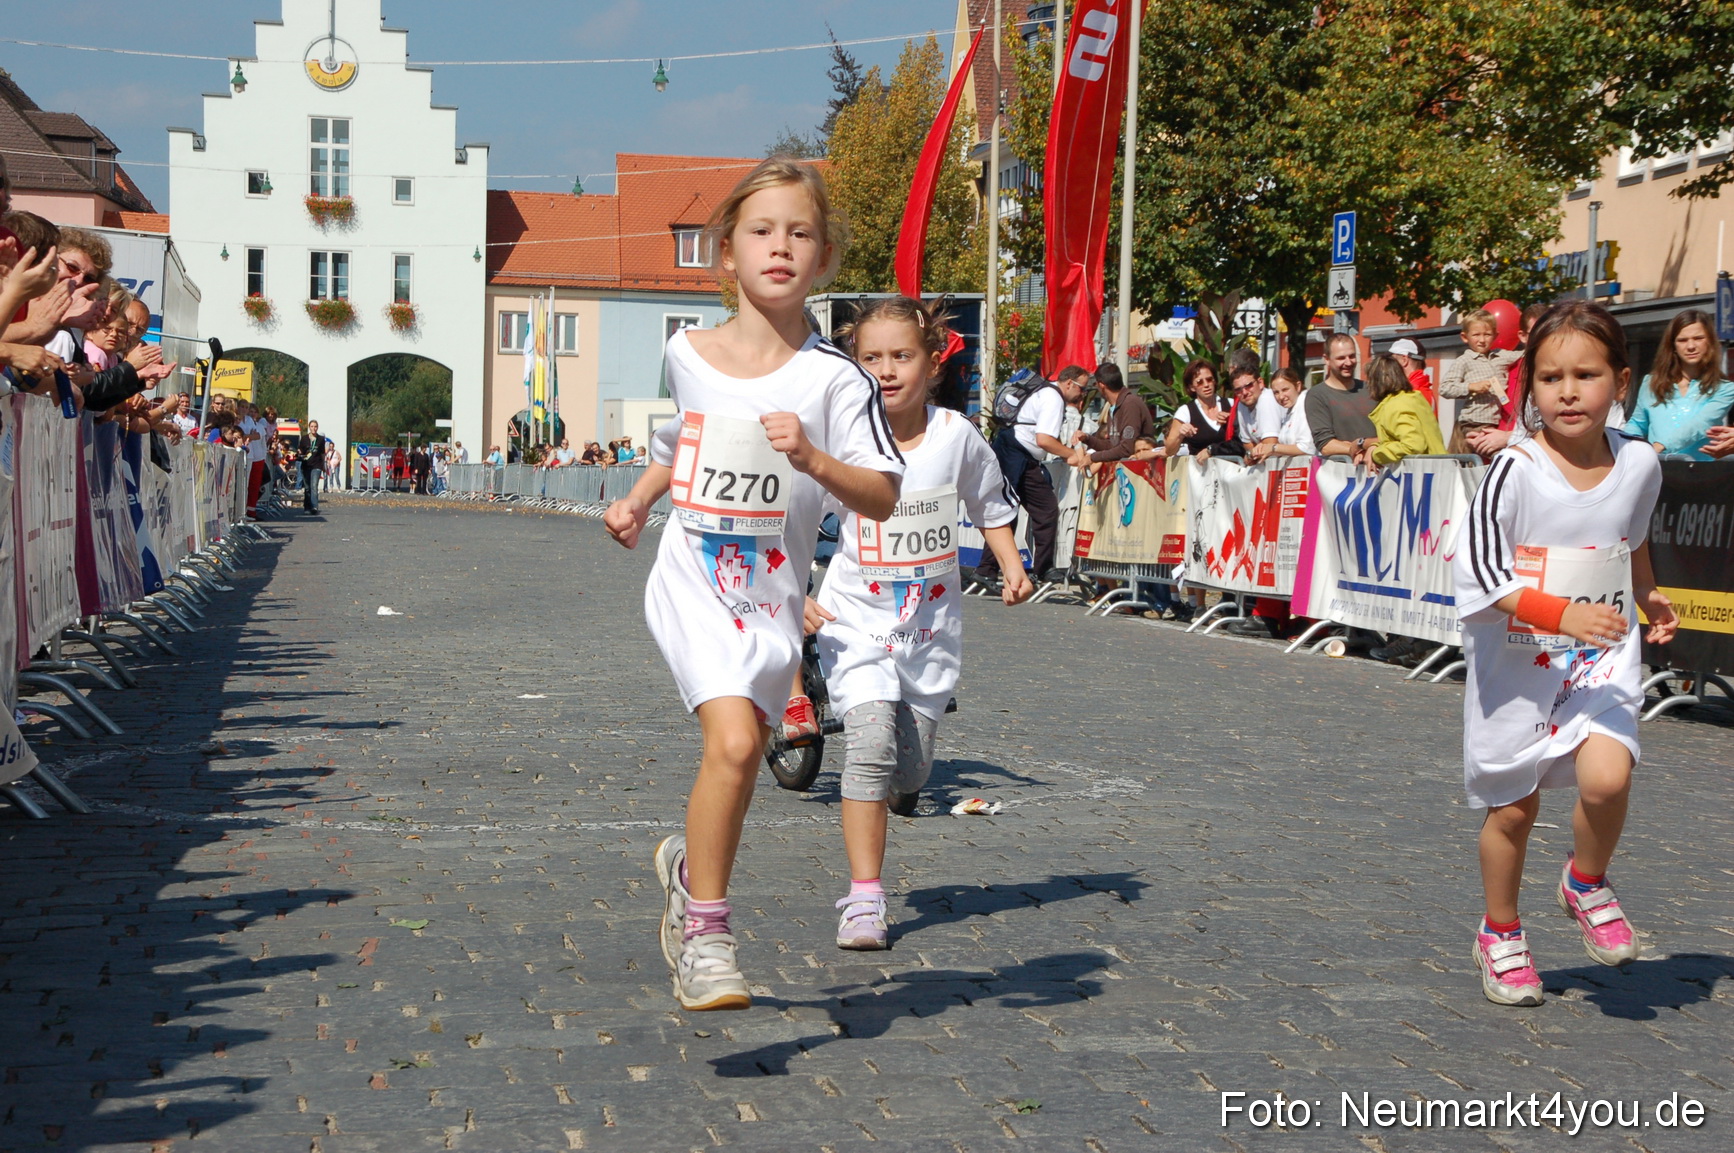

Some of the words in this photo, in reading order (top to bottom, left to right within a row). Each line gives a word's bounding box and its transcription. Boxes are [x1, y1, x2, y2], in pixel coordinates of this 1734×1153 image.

[1337, 219, 1351, 258] P
[215, 366, 248, 382] Glossner
[701, 467, 780, 504] 7270
[735, 517, 784, 528] PFLEIDERER
[1675, 503, 1726, 548] 09181
[888, 525, 951, 556] 7069
[862, 567, 900, 576] BOCK
[925, 557, 956, 571] PFLEIDERER
[1508, 633, 1561, 646] BOCK
